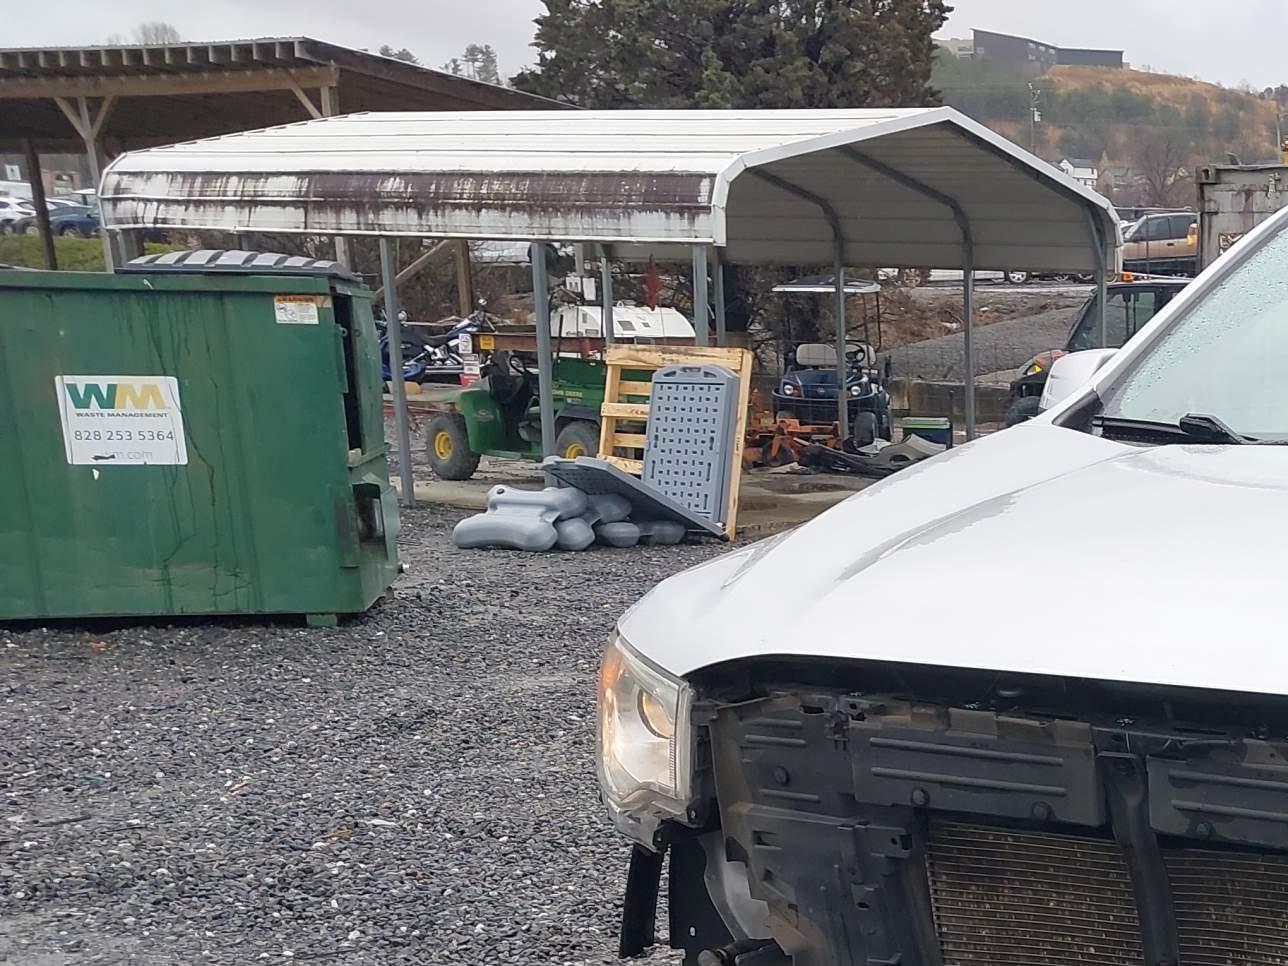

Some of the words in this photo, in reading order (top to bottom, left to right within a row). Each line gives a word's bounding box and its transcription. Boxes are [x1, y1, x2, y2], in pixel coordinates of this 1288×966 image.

[64, 383, 167, 410] WM
[75, 411, 106, 419] WASTE
[107, 411, 169, 419] MANAGEMENT
[74, 430, 102, 441] 828
[106, 430, 133, 441] 253
[137, 430, 175, 441] 5364
